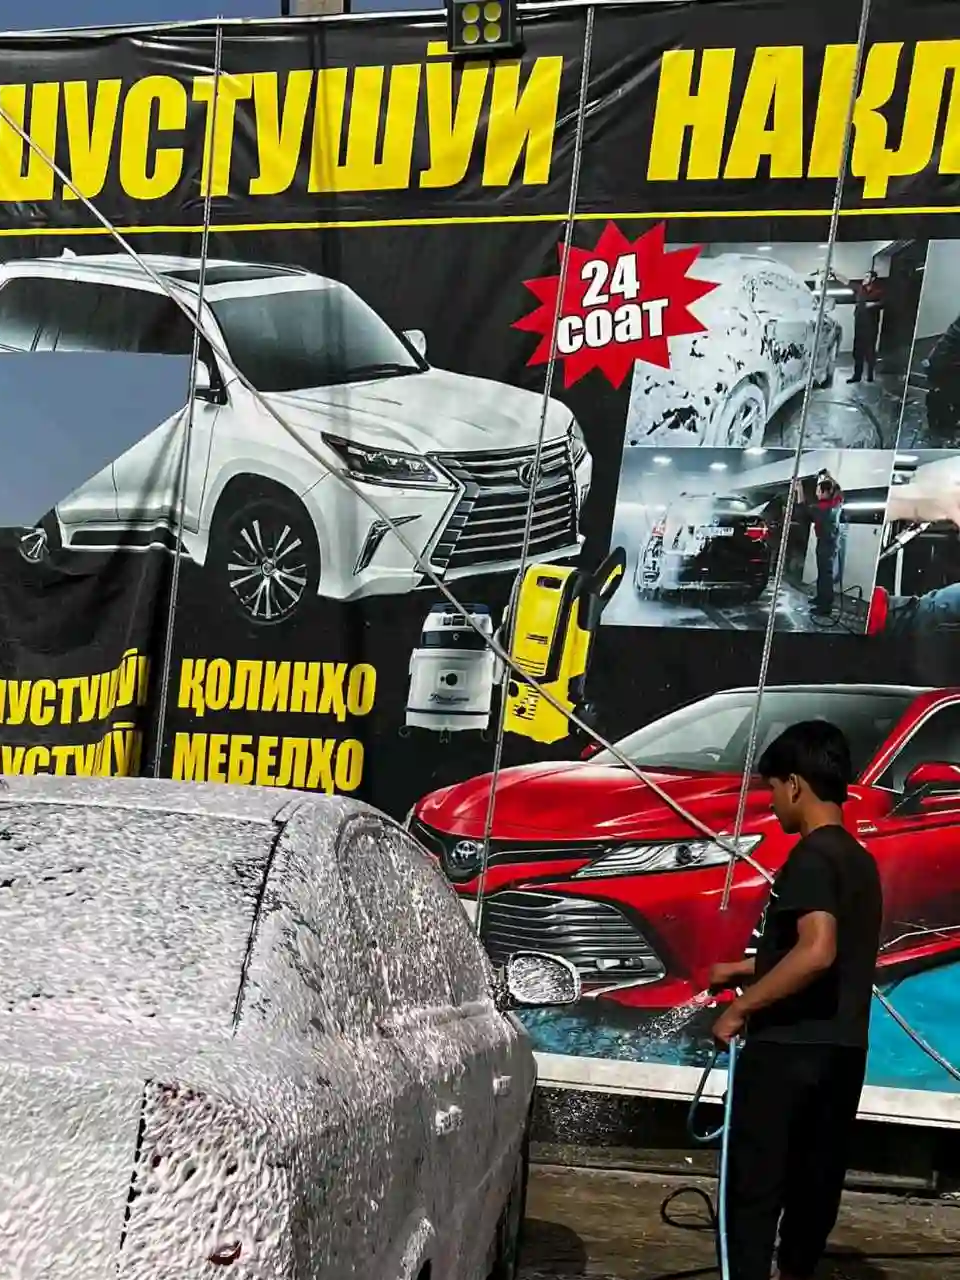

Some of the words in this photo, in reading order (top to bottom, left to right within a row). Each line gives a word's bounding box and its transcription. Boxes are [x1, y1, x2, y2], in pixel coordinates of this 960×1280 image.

[581, 253, 640, 308] 24
[178, 658, 377, 722] ҚОЛИНҲО
[171, 732, 364, 797] МЕБЕЛҲО
